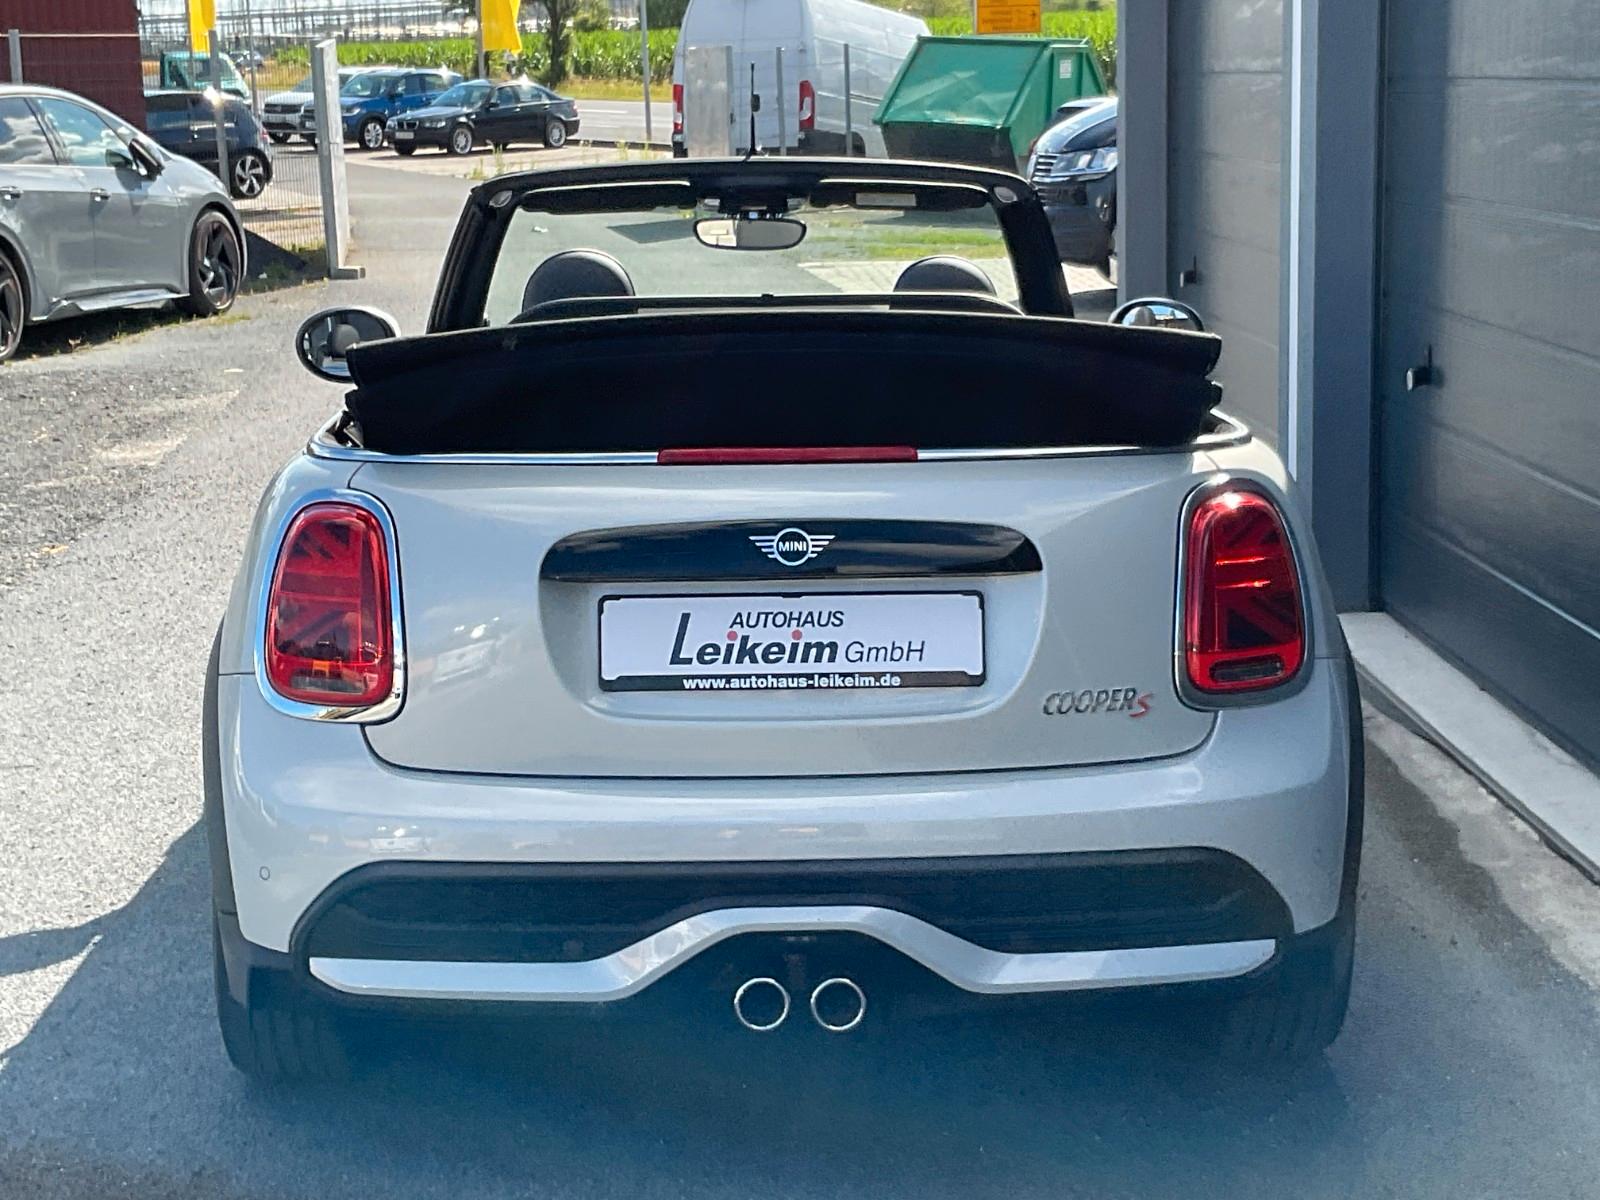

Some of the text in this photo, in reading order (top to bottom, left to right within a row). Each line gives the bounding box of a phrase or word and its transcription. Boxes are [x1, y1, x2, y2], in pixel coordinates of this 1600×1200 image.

[778, 541, 807, 552] MINI
[729, 610, 845, 629] AUTOHAUS
[668, 612, 926, 667] Leikeim GmbH
[682, 673, 901, 689] www.autohaus-leikeim.de
